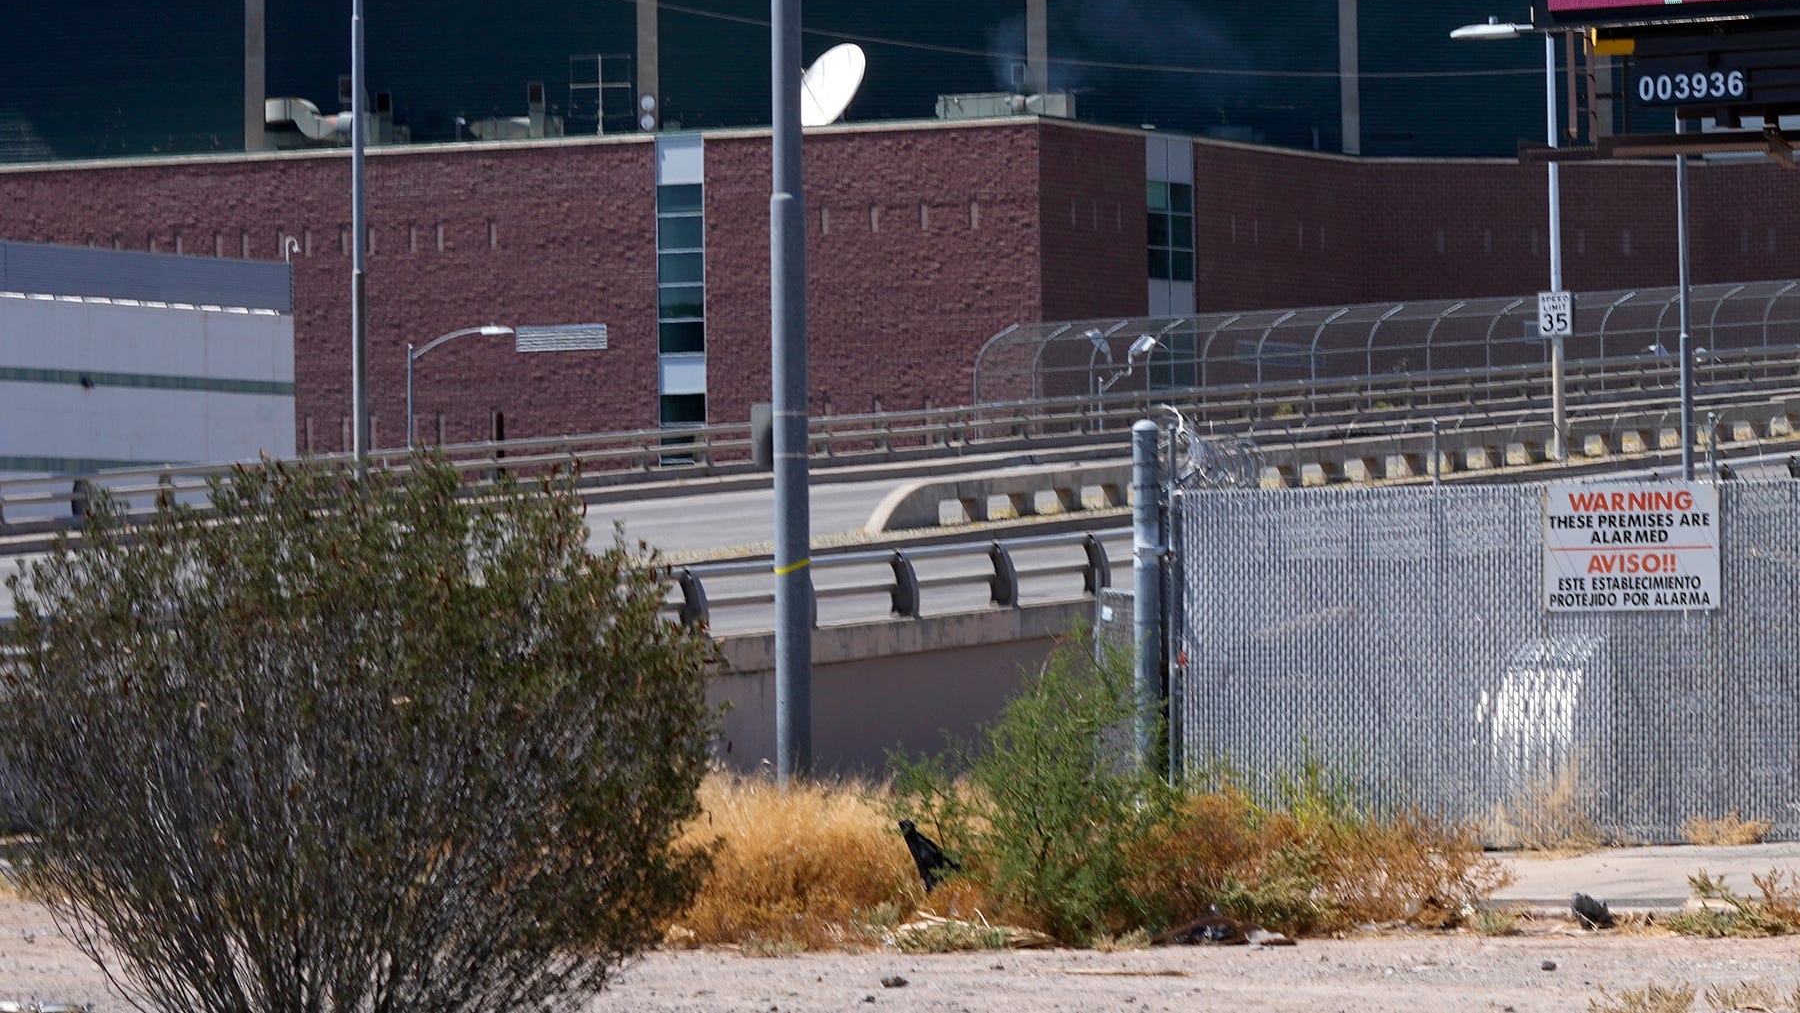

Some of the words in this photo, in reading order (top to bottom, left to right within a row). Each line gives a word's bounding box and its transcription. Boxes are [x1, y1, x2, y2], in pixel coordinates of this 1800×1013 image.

[1638, 70, 1744, 101] 003936
[1542, 313, 1568, 332] 35
[1568, 490, 1693, 513] WARNING
[1550, 515, 1594, 529] THESE
[1598, 514, 1673, 528] PREMISES
[1679, 513, 1710, 526] ARE
[1591, 529, 1668, 544] ALARMED
[1587, 553, 1676, 573] AVISO!!
[1558, 578, 1585, 591] ESTE
[1592, 576, 1701, 590] ESTABLECIMIENTO
[1550, 593, 1617, 607] PROTEJIDO
[1623, 593, 1650, 606] POR
[1654, 592, 1710, 605] ALARMA
